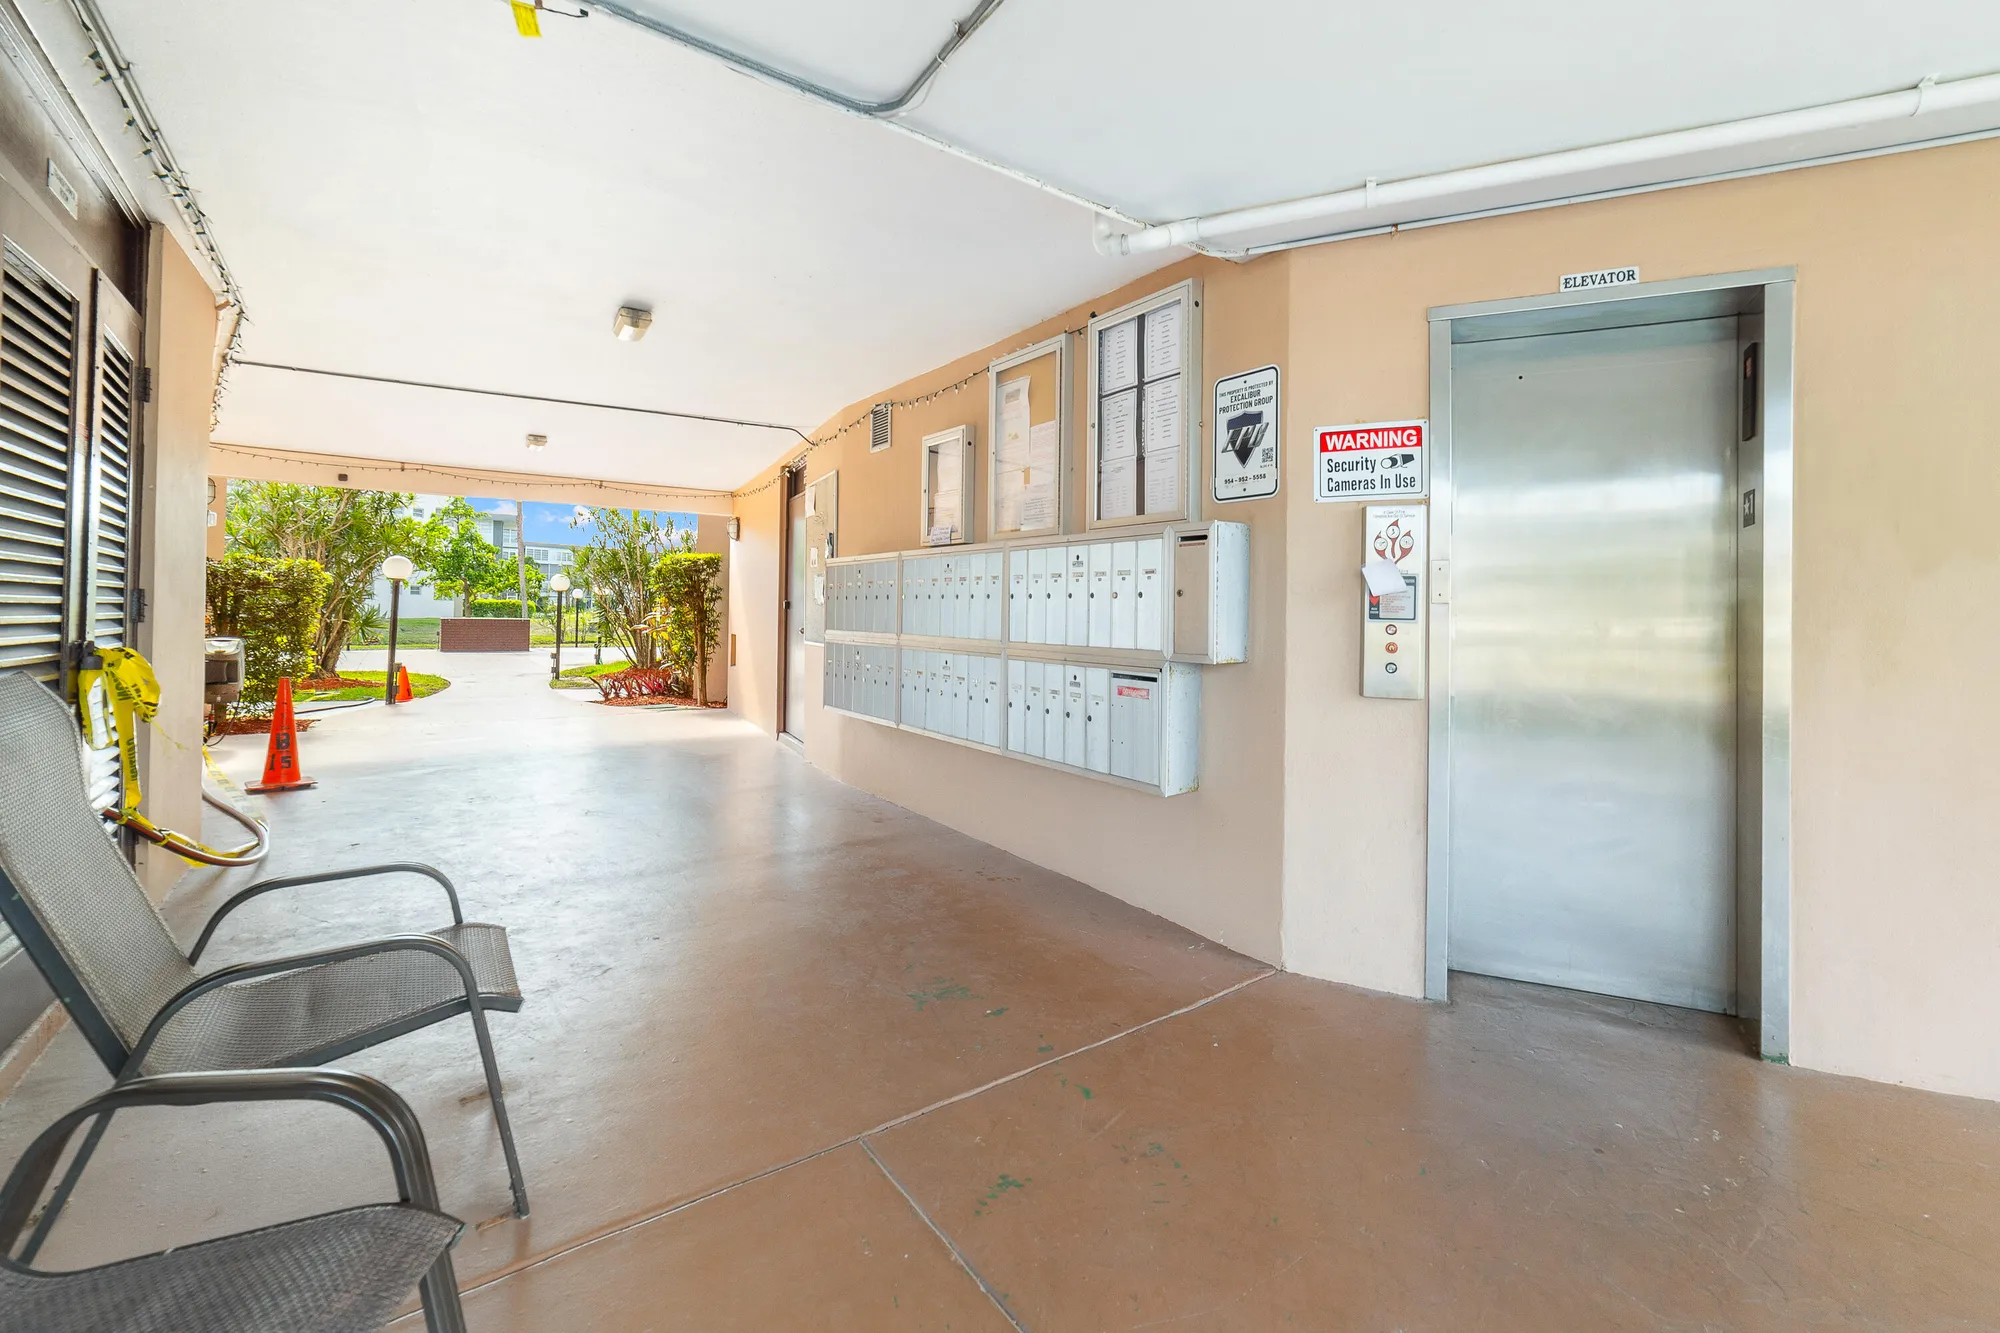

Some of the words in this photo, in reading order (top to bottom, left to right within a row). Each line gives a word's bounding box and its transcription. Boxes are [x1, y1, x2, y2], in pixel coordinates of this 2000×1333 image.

[1563, 269, 1637, 289] ELEVATOR
[1227, 387, 1244, 395] PROPERTY
[1248, 382, 1268, 390] PROTECTED
[1230, 389, 1261, 403] EXCALIBUR
[1218, 400, 1253, 415] PROTECTION
[1253, 395, 1274, 406] GROUP
[1325, 429, 1418, 451] WARNING
[1327, 456, 1377, 474] Security
[1327, 477, 1376, 492] Cameras
[1380, 474, 1391, 489] In
[1395, 473, 1416, 489] Use
[275, 731, 291, 751] B
